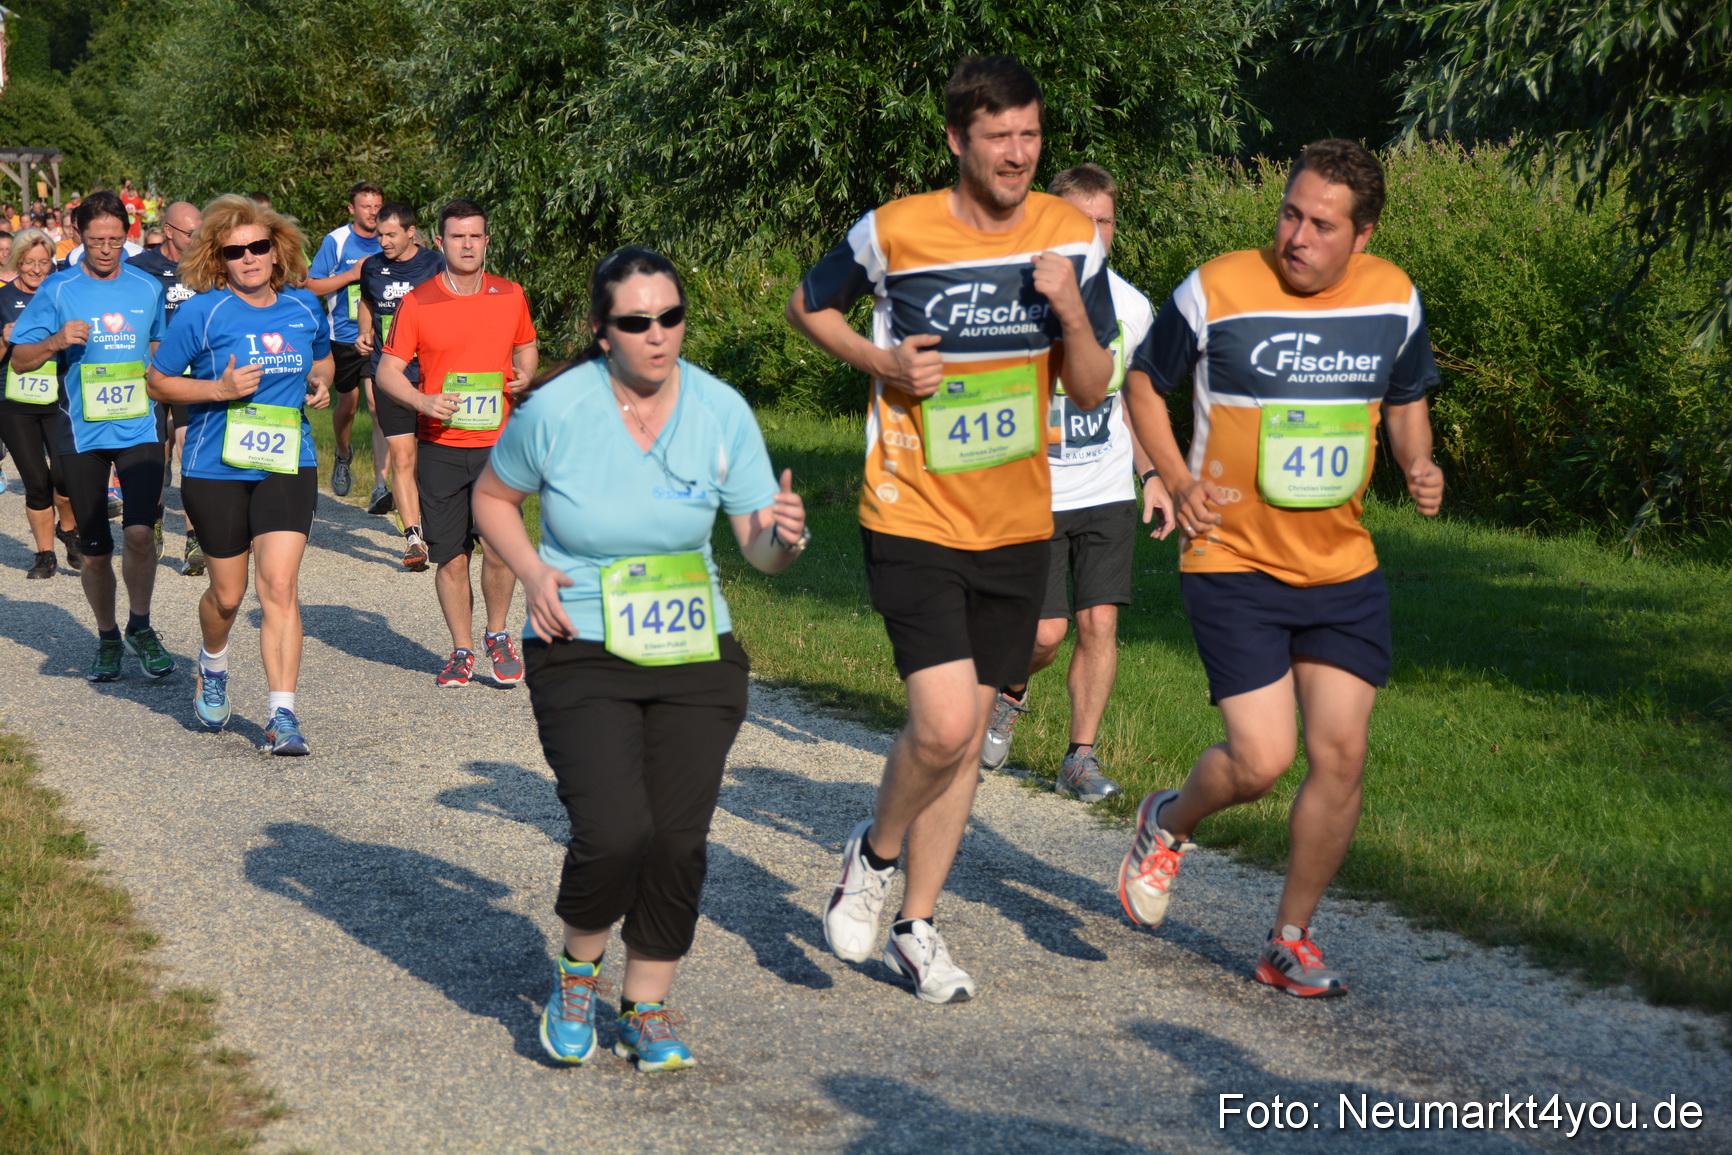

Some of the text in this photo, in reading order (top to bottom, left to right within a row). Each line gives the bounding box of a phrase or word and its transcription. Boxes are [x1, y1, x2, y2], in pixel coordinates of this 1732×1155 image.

[949, 300, 1052, 325] Fischer
[91, 318, 101, 334] I
[93, 333, 136, 344] camping
[246, 334, 260, 355] I
[250, 352, 303, 367] camping
[1276, 350, 1381, 371] Fischer
[18, 377, 49, 392] 175
[1287, 373, 1376, 383] AUTOMOBILE
[96, 385, 135, 404] 487
[948, 408, 1016, 444] 418
[1071, 414, 1103, 437] RW
[239, 430, 286, 454] 492
[1283, 446, 1348, 477] 410
[619, 597, 706, 636] 1426
